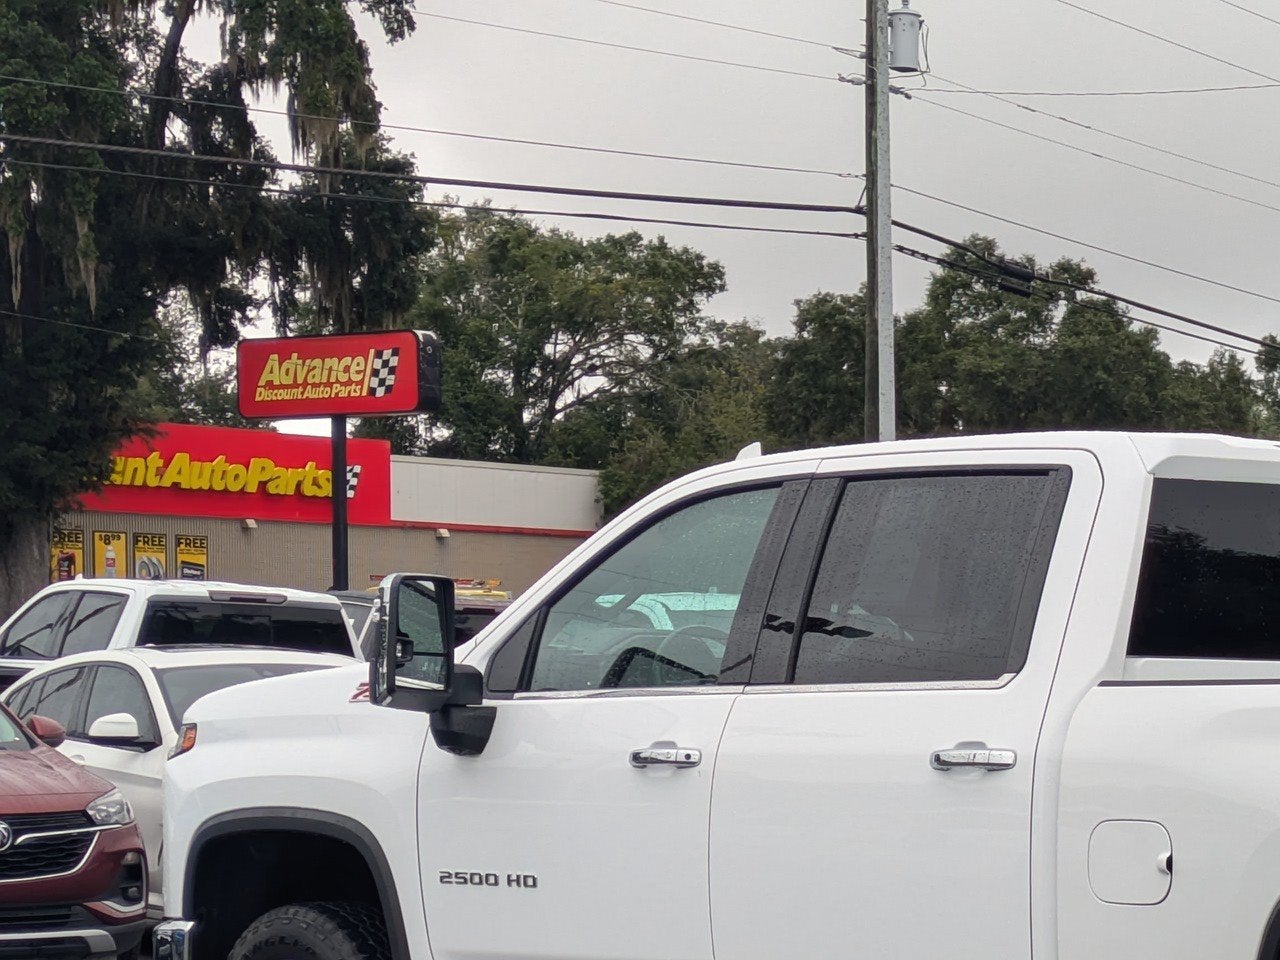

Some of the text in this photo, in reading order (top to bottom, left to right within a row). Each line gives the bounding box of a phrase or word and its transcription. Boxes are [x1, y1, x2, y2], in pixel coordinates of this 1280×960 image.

[257, 352, 365, 386] Advance
[255, 383, 361, 402] Discount Auto Parts
[135, 534, 166, 547] FREE
[177, 536, 207, 549] FREE
[438, 871, 538, 889] 2500 HD
